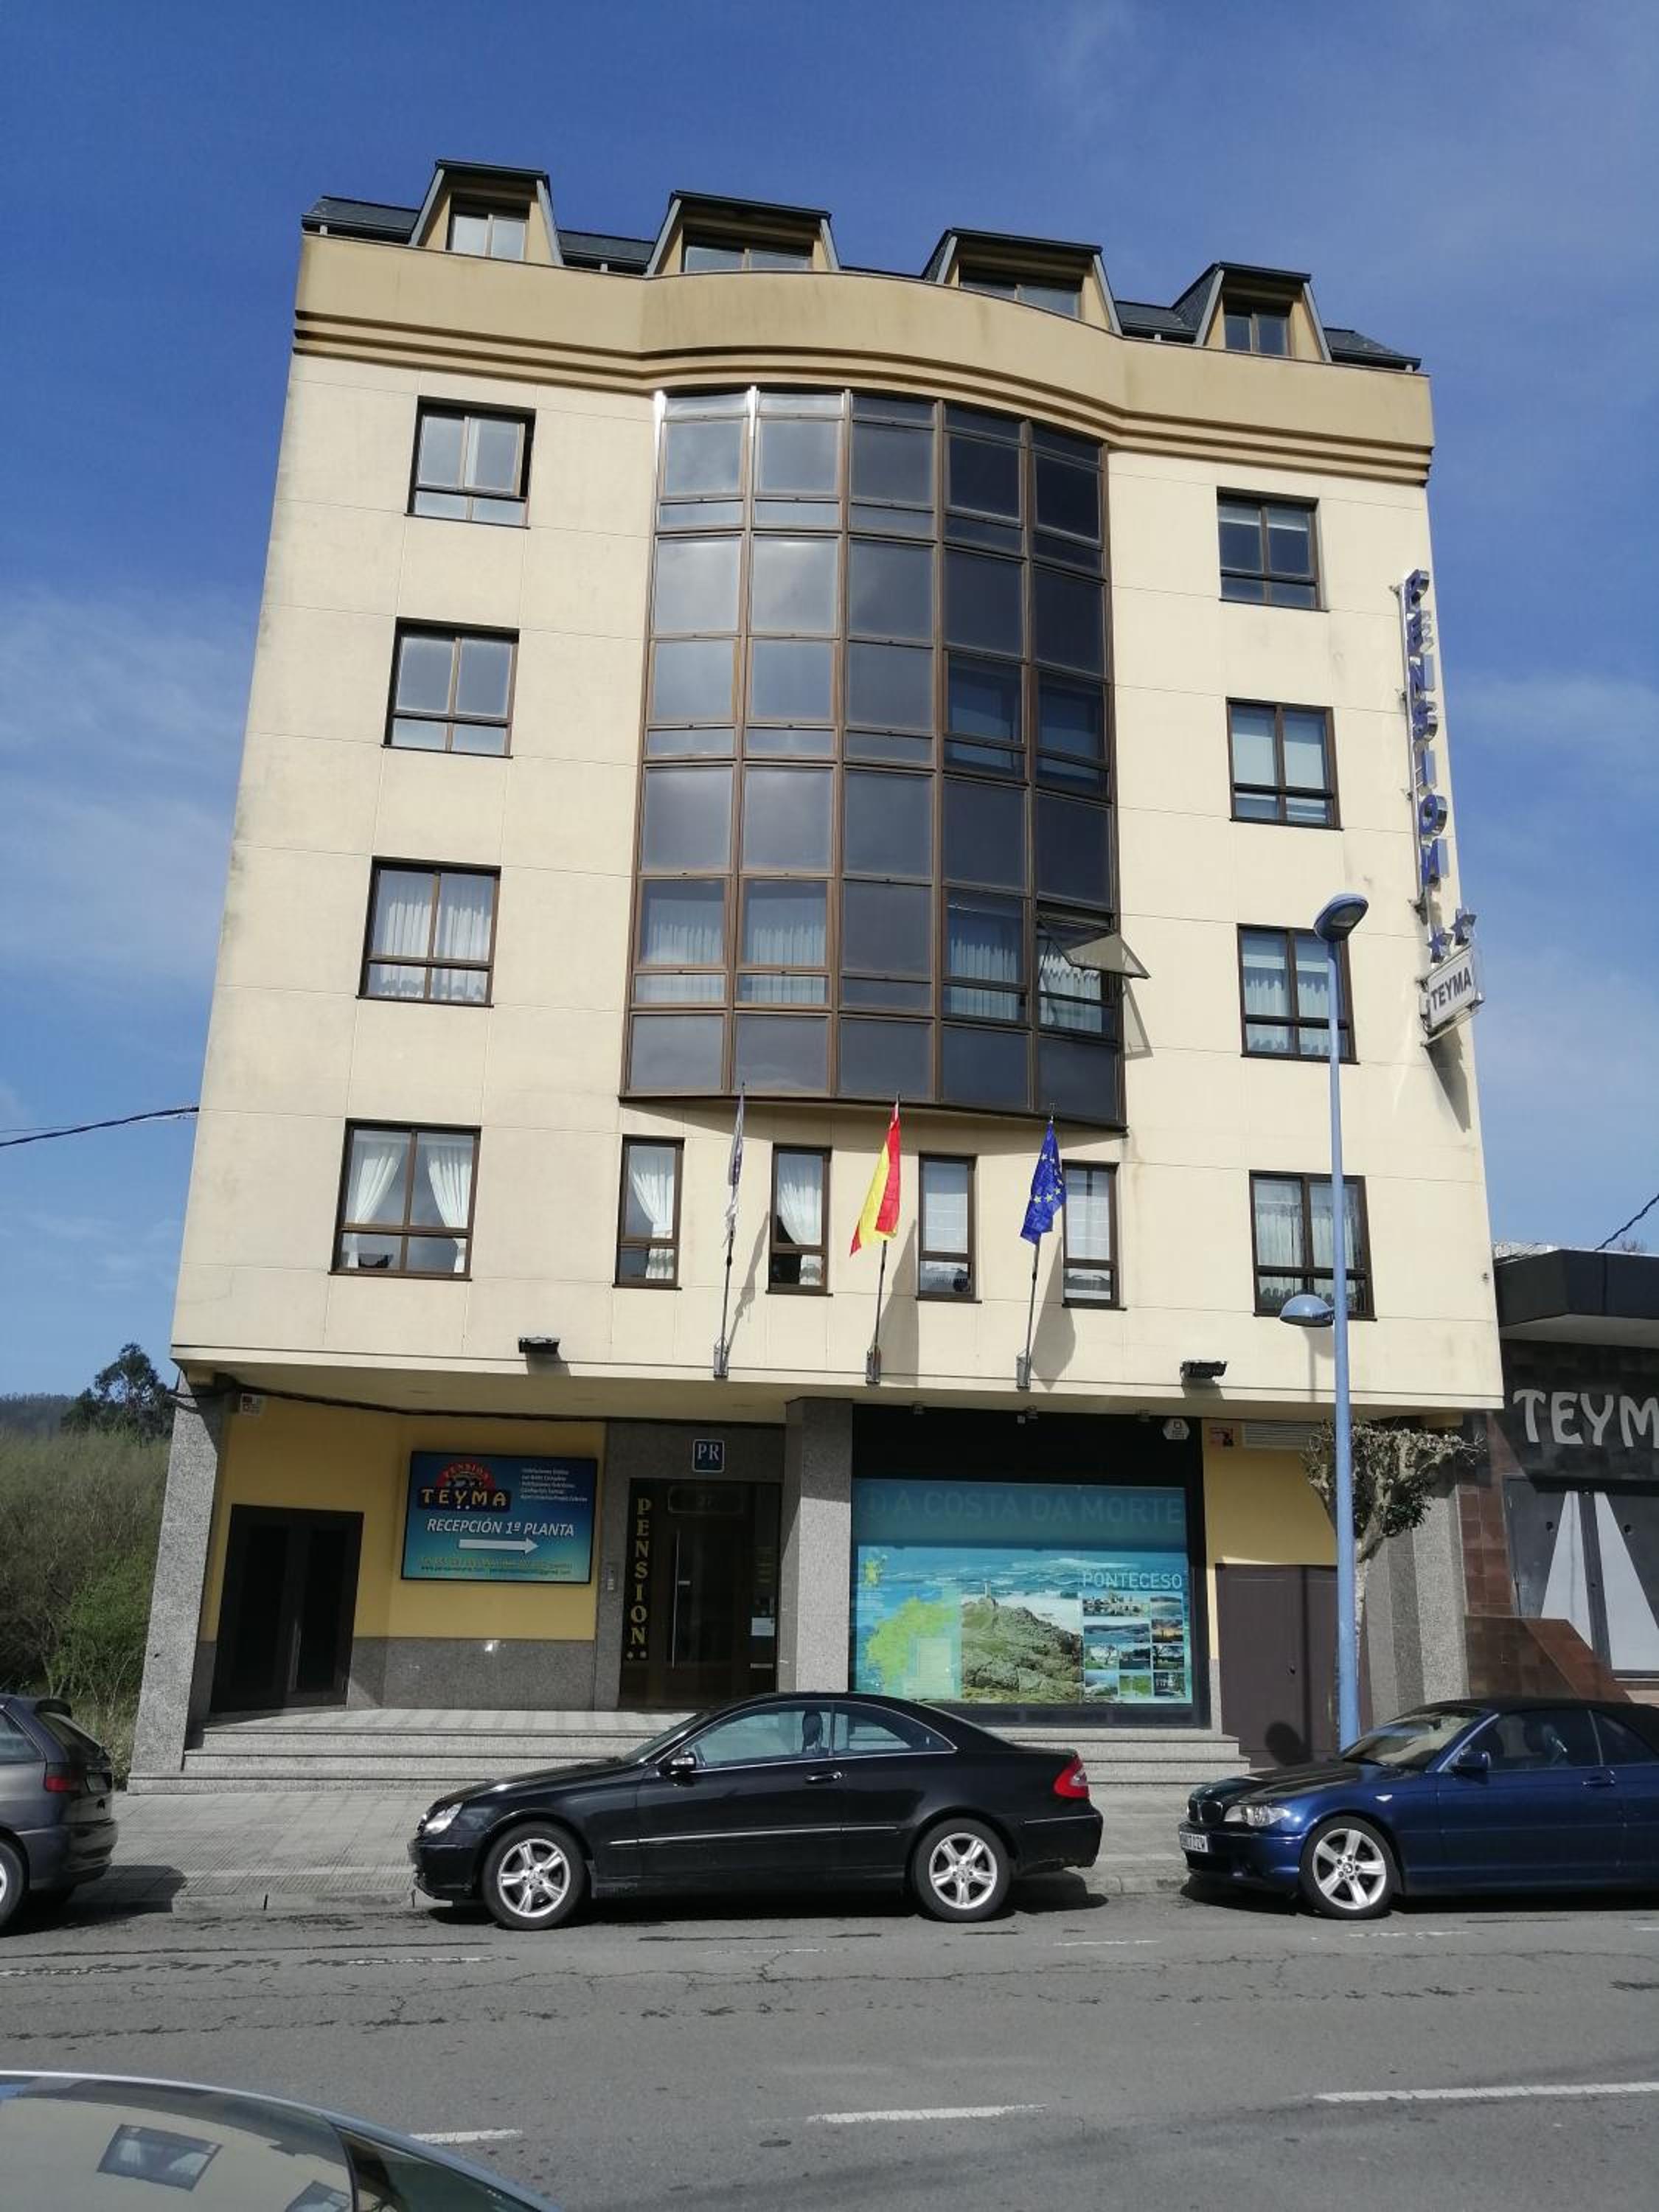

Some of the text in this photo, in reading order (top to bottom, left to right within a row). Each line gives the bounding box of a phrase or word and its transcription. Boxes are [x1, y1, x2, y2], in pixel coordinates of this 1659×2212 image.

[1404, 568, 1450, 887] PENSION
[1430, 964, 1472, 1009] TEYMA
[697, 1443, 720, 1461] PR
[421, 1488, 507, 1506] TEYMA
[923, 1491, 1021, 1522] COSTA
[1030, 1494, 1073, 1523] DA
[1081, 1496, 1183, 1525] MORTE
[427, 1517, 502, 1534] RECEPCIÓN
[524, 1523, 574, 1537] PLANTA
[1082, 1571, 1183, 1590] PONTECESO
